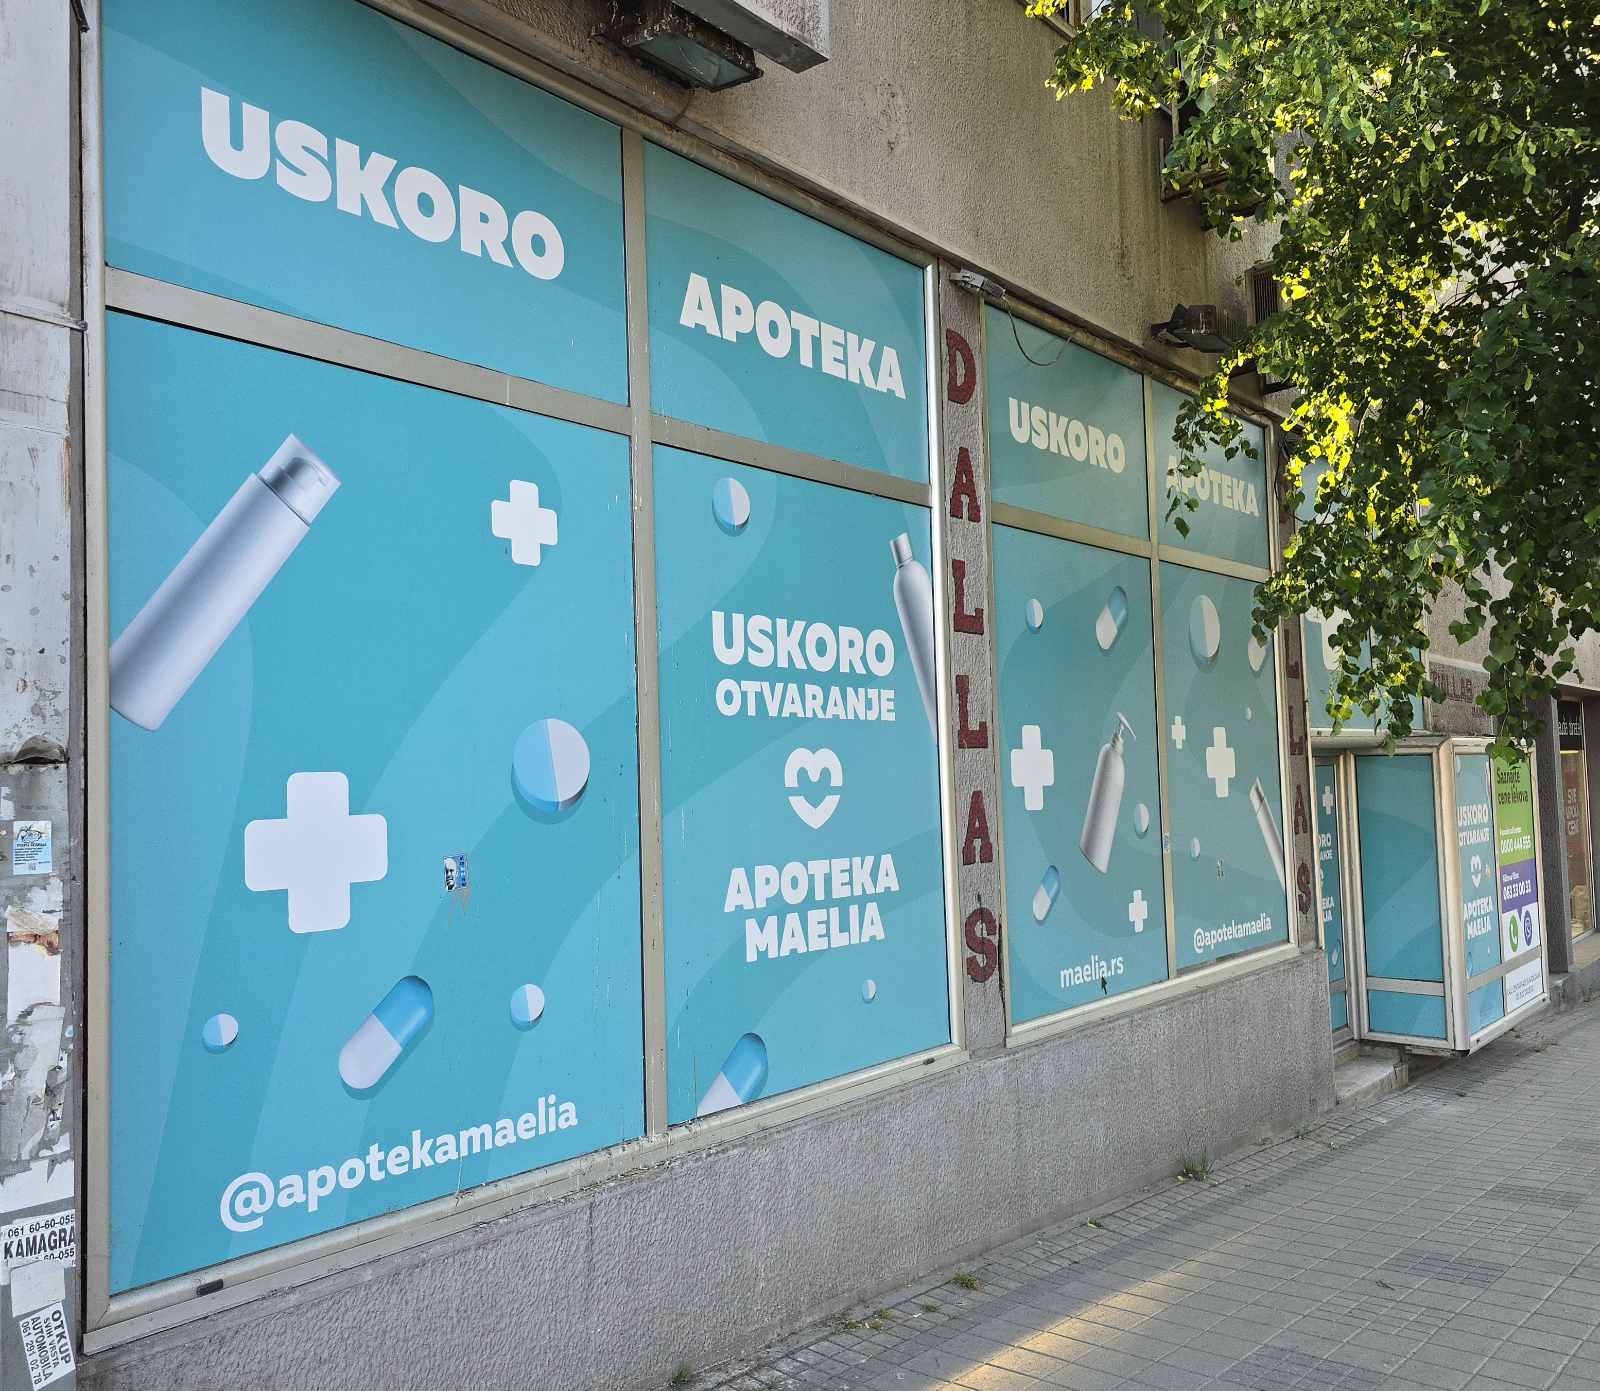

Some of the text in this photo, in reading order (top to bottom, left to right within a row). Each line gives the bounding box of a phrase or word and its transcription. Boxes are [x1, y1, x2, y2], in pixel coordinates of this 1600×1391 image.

[201, 87, 565, 280] USKORO
[679, 271, 906, 400] APOTEKA
[1008, 396, 1127, 474] USKORO
[711, 610, 895, 677] USKORO
[947, 328, 1000, 982] DALLAS
[715, 678, 897, 722] OTVARANJE
[1457, 803, 1489, 827] USKORO
[723, 853, 900, 913] APOTEKA
[1463, 895, 1493, 920] APOTEKA
[745, 901, 886, 963] MAELIA
[1193, 912, 1273, 954] @apotekamaelia
[1466, 914, 1492, 940] MAELIA
[1060, 954, 1124, 989] maelia.rs
[220, 1094, 578, 1232] @apotekamaelia
[3, 1226, 75, 1260] KAMAGRA
[8, 1214, 75, 1238] 061 60-60-055
[21, 1321, 32, 1338] 061
[30, 1316, 53, 1381] AUTOMOBILA
[51, 1309, 72, 1364] OTKUP
